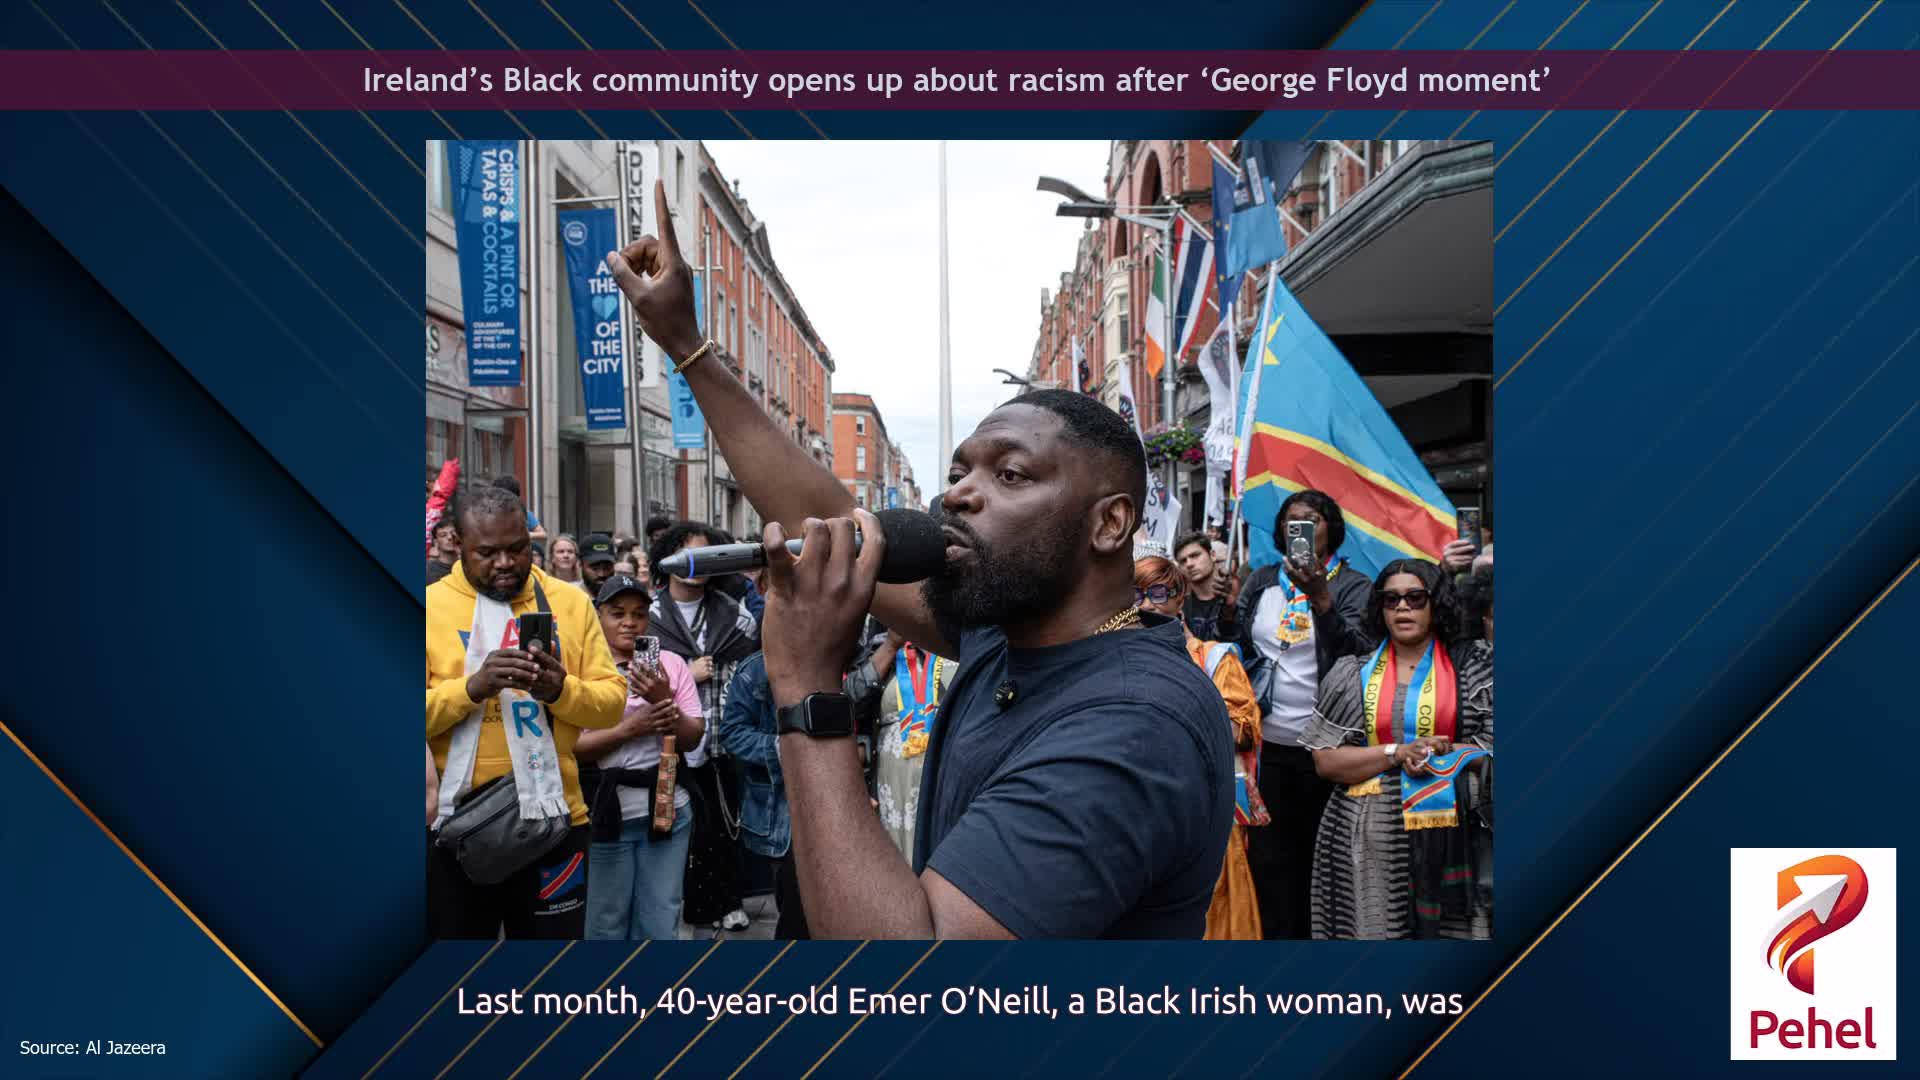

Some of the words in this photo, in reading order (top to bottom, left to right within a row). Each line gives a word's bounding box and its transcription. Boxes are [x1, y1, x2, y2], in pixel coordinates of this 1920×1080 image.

[481, 148, 497, 202] TAPAS
[499, 149, 514, 205] CRISPS
[482, 206, 497, 218] &
[500, 210, 514, 223] &
[500, 227, 514, 241] A
[483, 222, 499, 314] COCKTAILS
[500, 245, 515, 279] PINT
[500, 284, 515, 309] OR
[588, 278, 617, 294] THE
[596, 321, 619, 338] OF
[592, 339, 621, 356] THE
[583, 358, 621, 375] CITY
[1365, 683, 1378, 734] CONGO
[1418, 704, 1433, 737] CON
